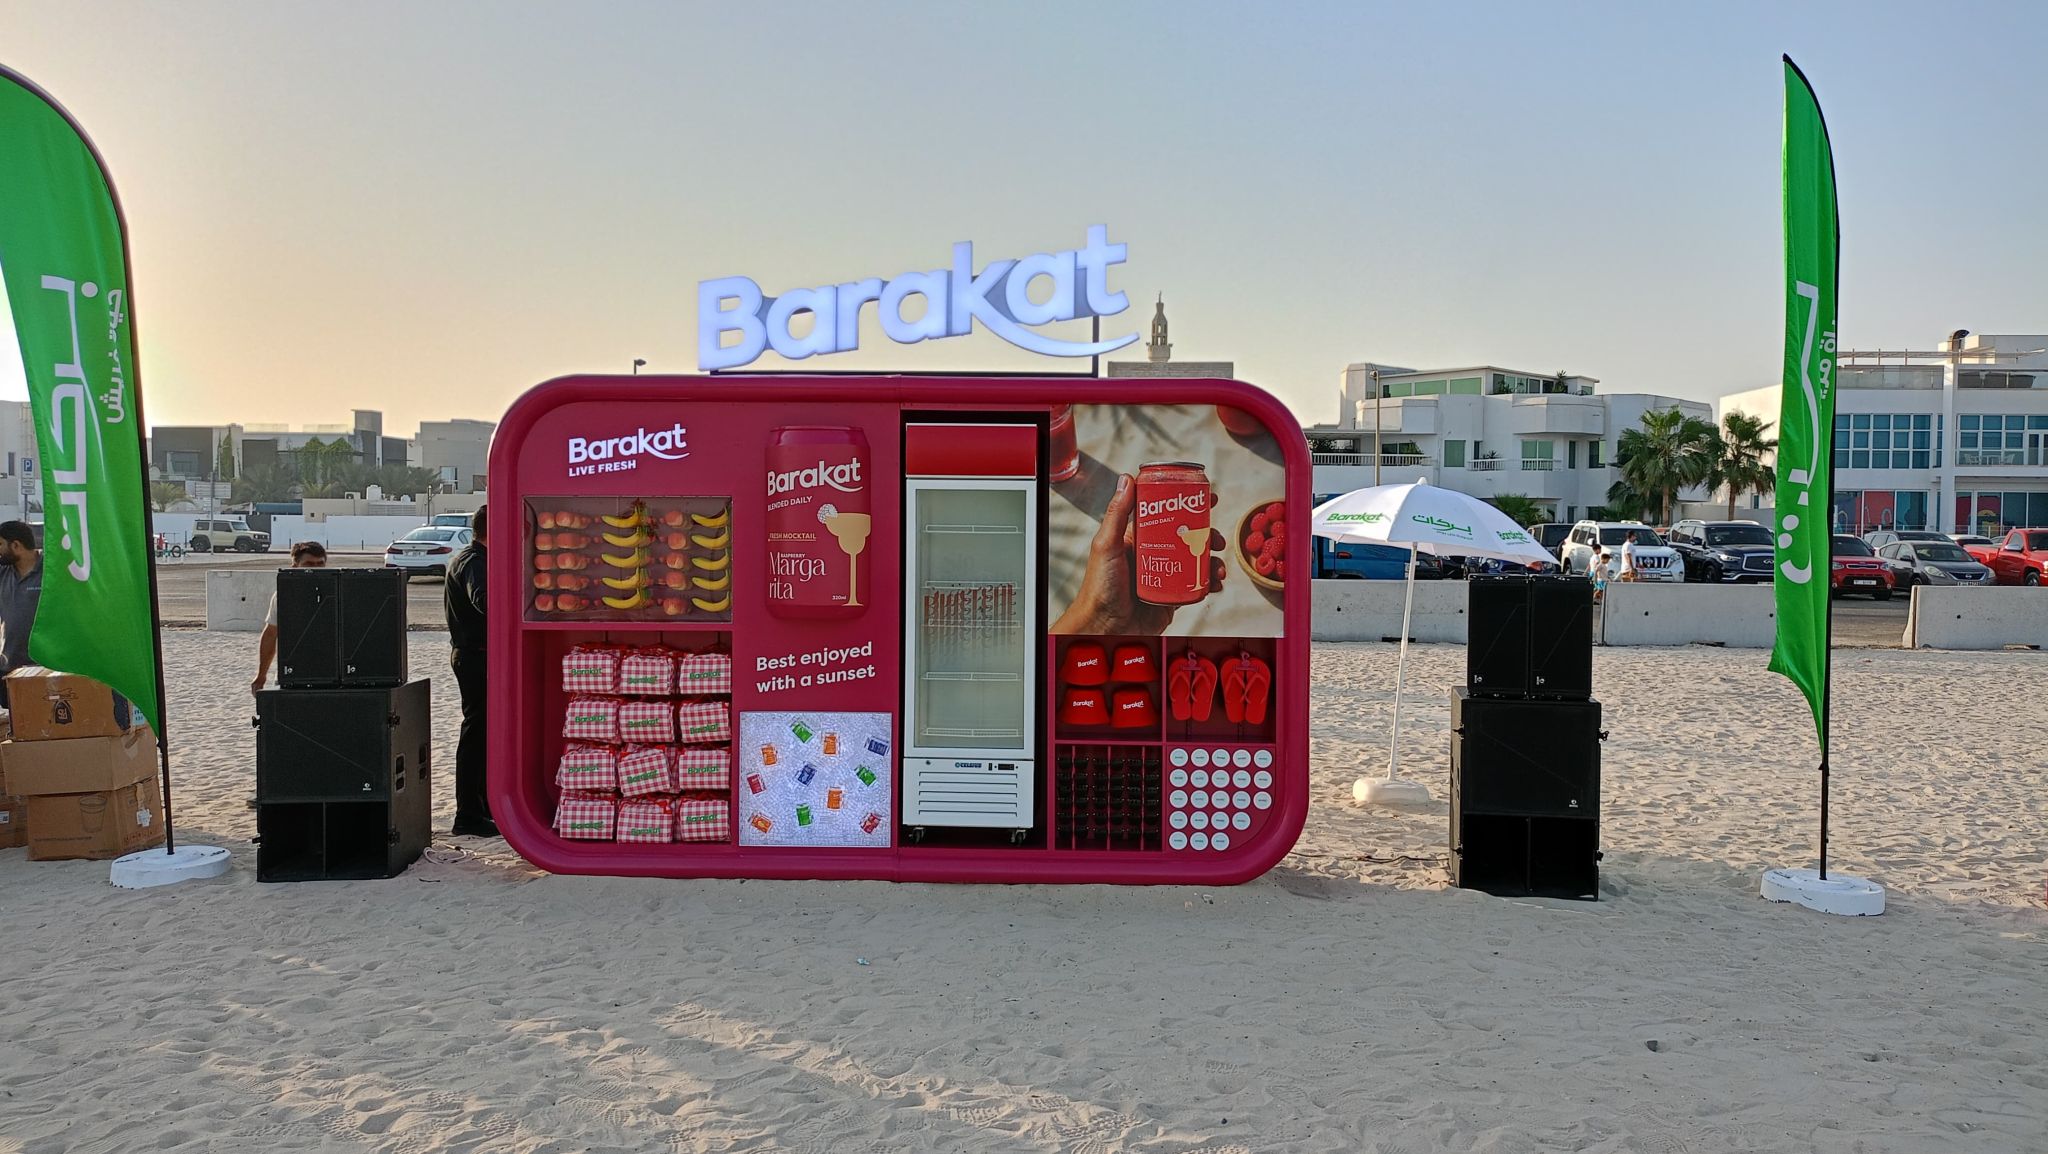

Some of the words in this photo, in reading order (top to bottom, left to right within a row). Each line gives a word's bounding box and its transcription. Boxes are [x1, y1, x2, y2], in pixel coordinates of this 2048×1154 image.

[698, 223, 1140, 371] Barakat
[568, 423, 690, 464] Barakat
[568, 465, 595, 477] LIVE
[598, 459, 637, 473] FRESH
[767, 457, 863, 497] Barakat
[767, 499, 789, 512] BLENDED
[790, 495, 813, 506] DAILY
[1139, 490, 1207, 518] Barakat
[1139, 519, 1159, 528] BLENDED
[1160, 516, 1175, 524] DAILY
[1327, 512, 1384, 523] Barakat
[1412, 515, 1473, 536] بركات
[783, 532, 817, 540] MOCKTAIL
[769, 551, 827, 582] Marga
[1141, 554, 1183, 577] Marga
[769, 576, 794, 600] rita
[1141, 573, 1162, 588] rita
[756, 653, 796, 672] Best
[800, 641, 872, 666] enjoyed
[1077, 658, 1097, 668] Barakat
[1124, 656, 1145, 666] Barakat
[756, 674, 796, 693] with
[800, 675, 812, 687] a
[816, 664, 876, 685] sunset
